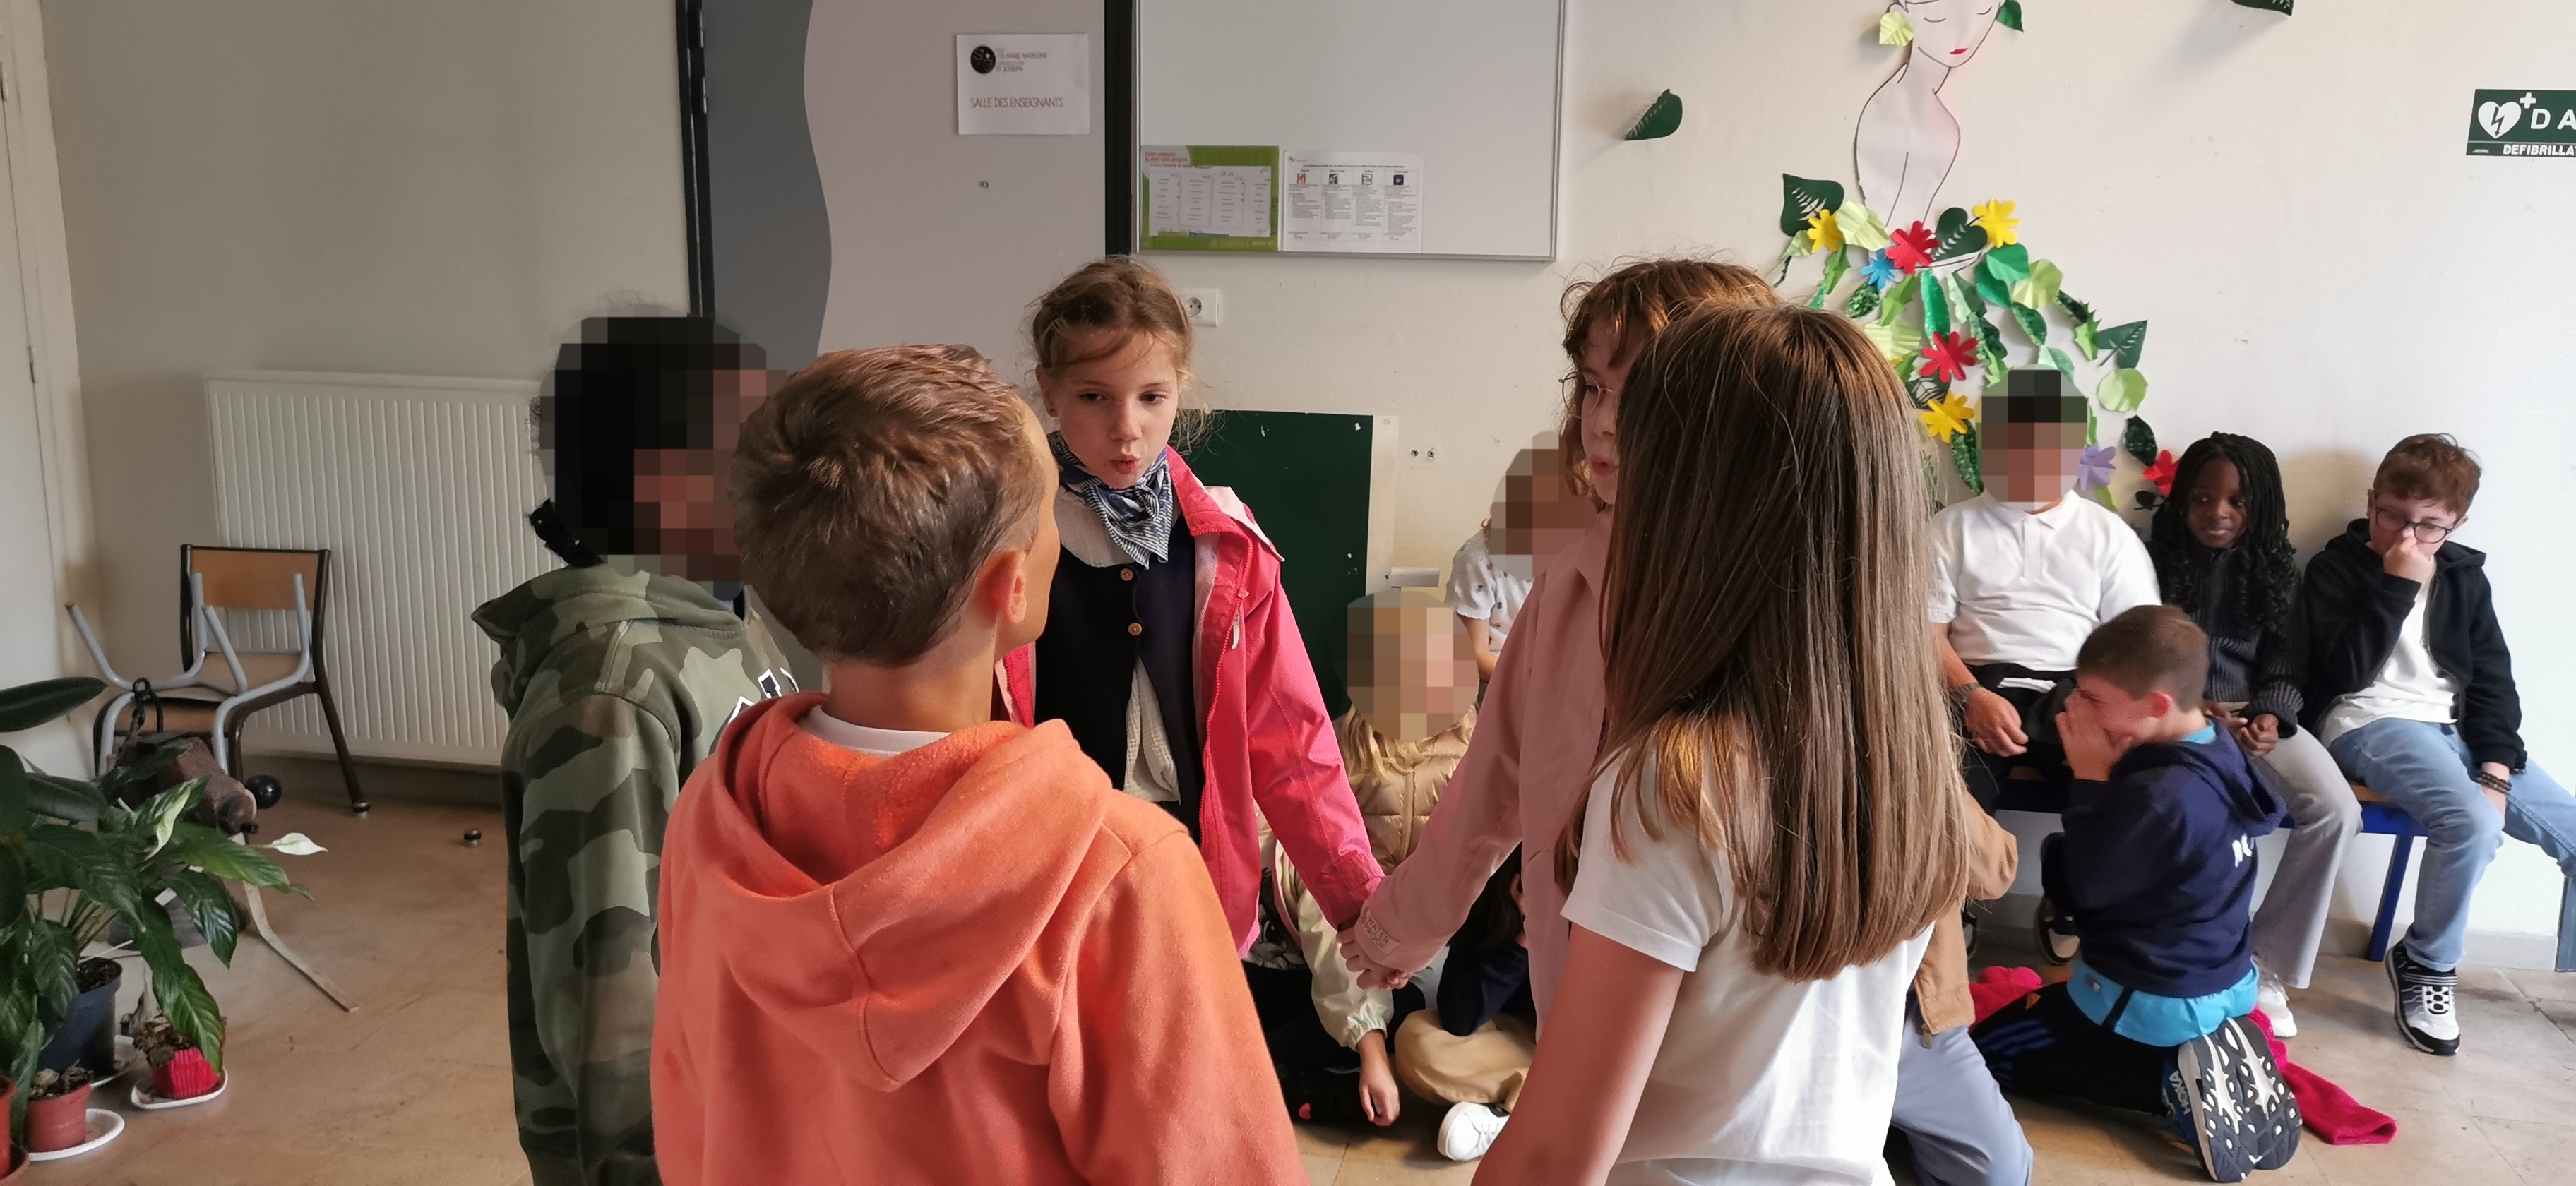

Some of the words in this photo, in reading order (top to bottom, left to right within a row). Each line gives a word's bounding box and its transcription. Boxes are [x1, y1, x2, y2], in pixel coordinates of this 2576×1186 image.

[971, 97, 992, 108] SALLE
[994, 97, 1008, 108] DES
[1010, 97, 1064, 108] ENSEIGNANTS
[2503, 144, 2576, 156] DEFIBRILLA
[1364, 922, 1387, 950] PROOF
[1367, 917, 1390, 944] WATER
[2169, 1070, 2192, 1115] HOKA
